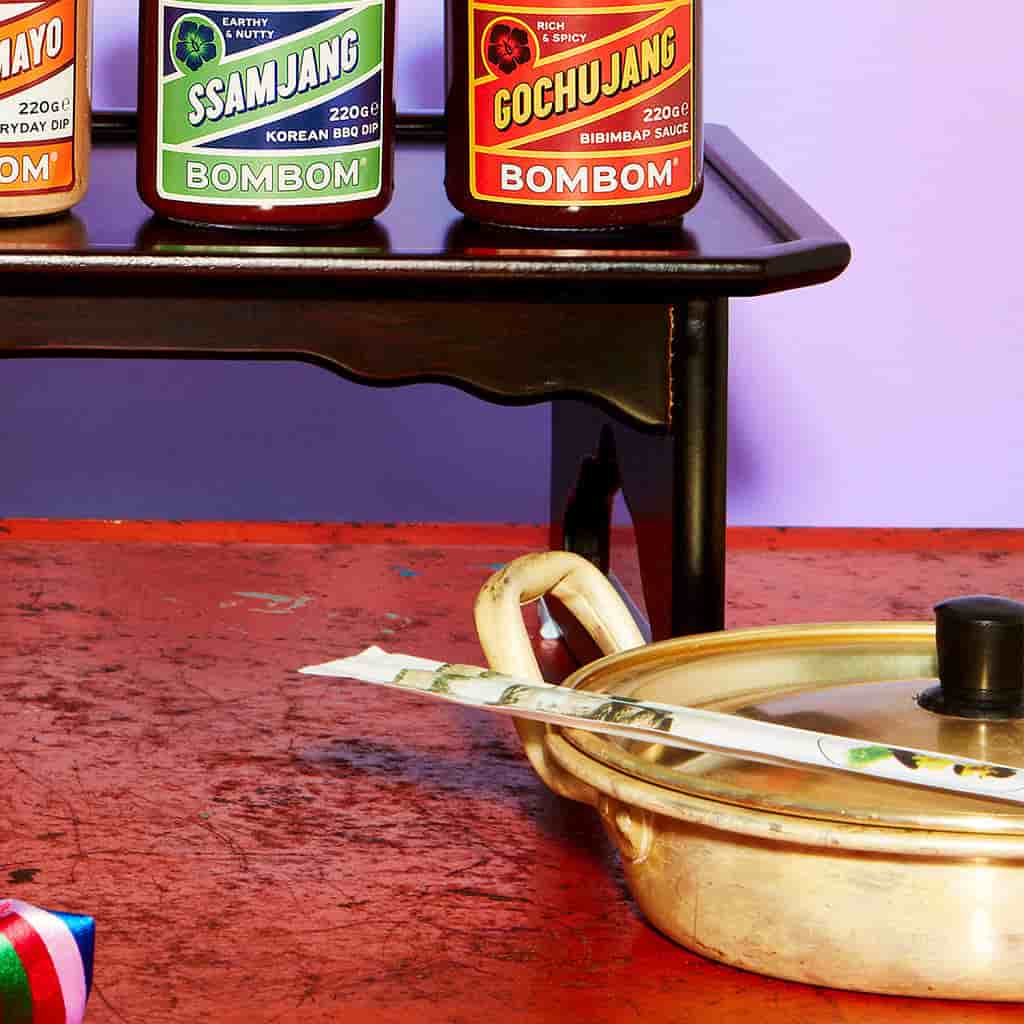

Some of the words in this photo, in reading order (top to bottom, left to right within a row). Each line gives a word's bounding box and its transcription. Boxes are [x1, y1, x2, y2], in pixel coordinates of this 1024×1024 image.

[222, 17, 268, 27] EARTHY
[537, 21, 565, 31] RICH
[236, 29, 275, 39] NUTTY
[552, 33, 587, 43] SPICY
[187, 27, 360, 127] SSAMJANG
[493, 26, 677, 131] GOCHUJANG
[51, 118, 70, 131] DIP
[266, 128, 329, 143] KOREAN
[333, 126, 359, 139] BBQ
[362, 123, 379, 136] DIP
[580, 130, 650, 145] BIBIMBAP
[655, 123, 689, 139] SAUCE
[185, 158, 361, 193] BOMBOM
[500, 158, 673, 194] BOMBOM
